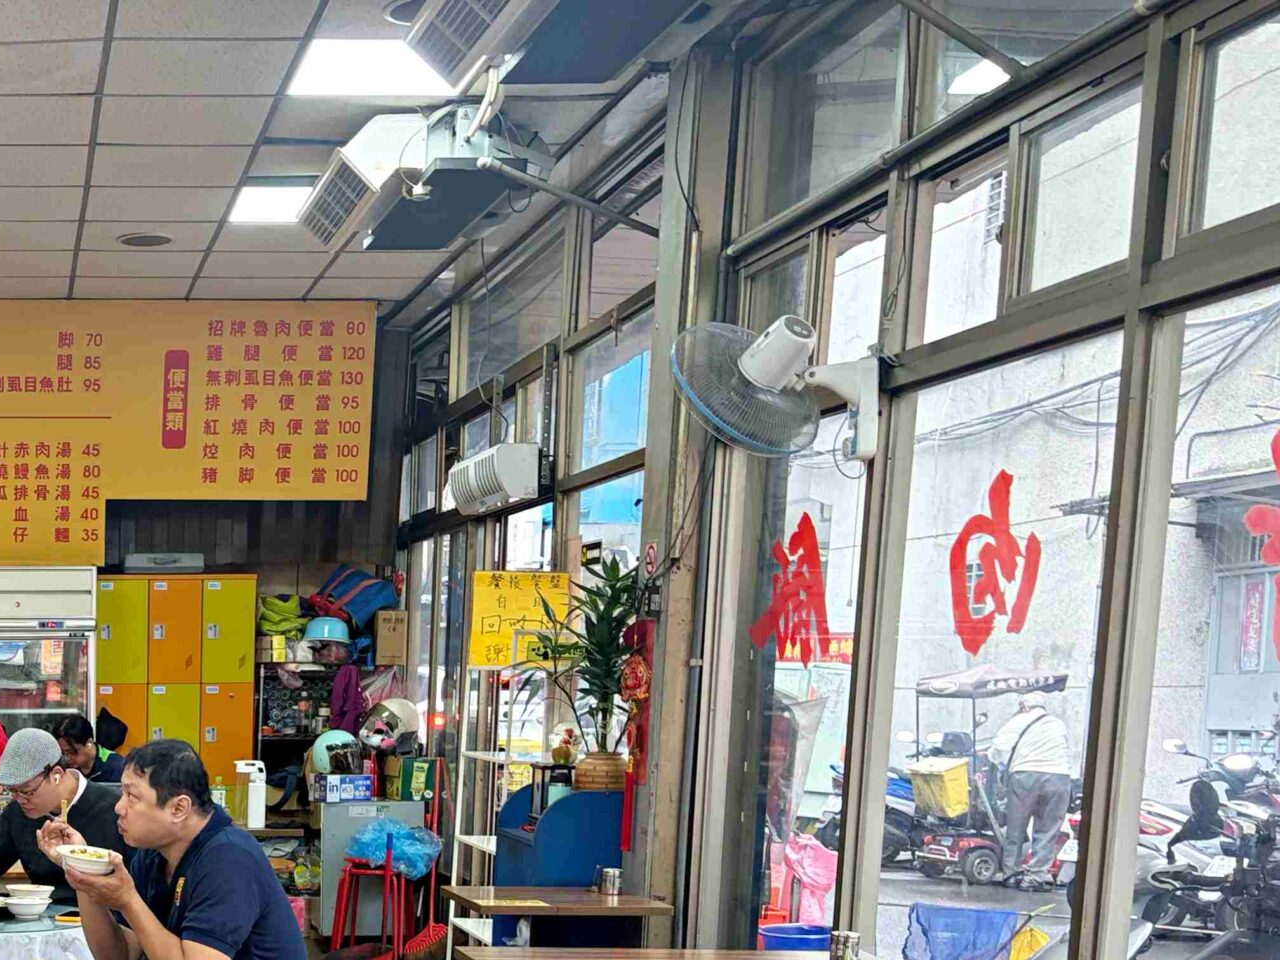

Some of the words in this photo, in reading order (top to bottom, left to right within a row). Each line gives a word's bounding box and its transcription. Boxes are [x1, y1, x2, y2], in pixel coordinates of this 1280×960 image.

[208, 320, 335, 337] 招牌魯肉便當
[86, 333, 102, 347] 70
[207, 345, 333, 361] 雞腿便當
[343, 347, 365, 360] 120
[84, 356, 101, 370] 85
[206, 370, 332, 386] 無刺虱目魚便當
[341, 371, 363, 385] 130
[83, 379, 100, 392] 95
[165, 368, 188, 431] 便當類
[205, 394, 331, 411] 排骨便當
[341, 396, 359, 409] 95
[203, 419, 329, 435] 紅燒肉便當
[338, 421, 360, 434] 100
[82, 444, 100, 457] 45
[337, 445, 359, 457] 100
[83, 465, 100, 478] 80
[336, 469, 358, 482] 100
[82, 486, 99, 499] 45
[80, 508, 98, 520] 40
[82, 529, 98, 541] 35
